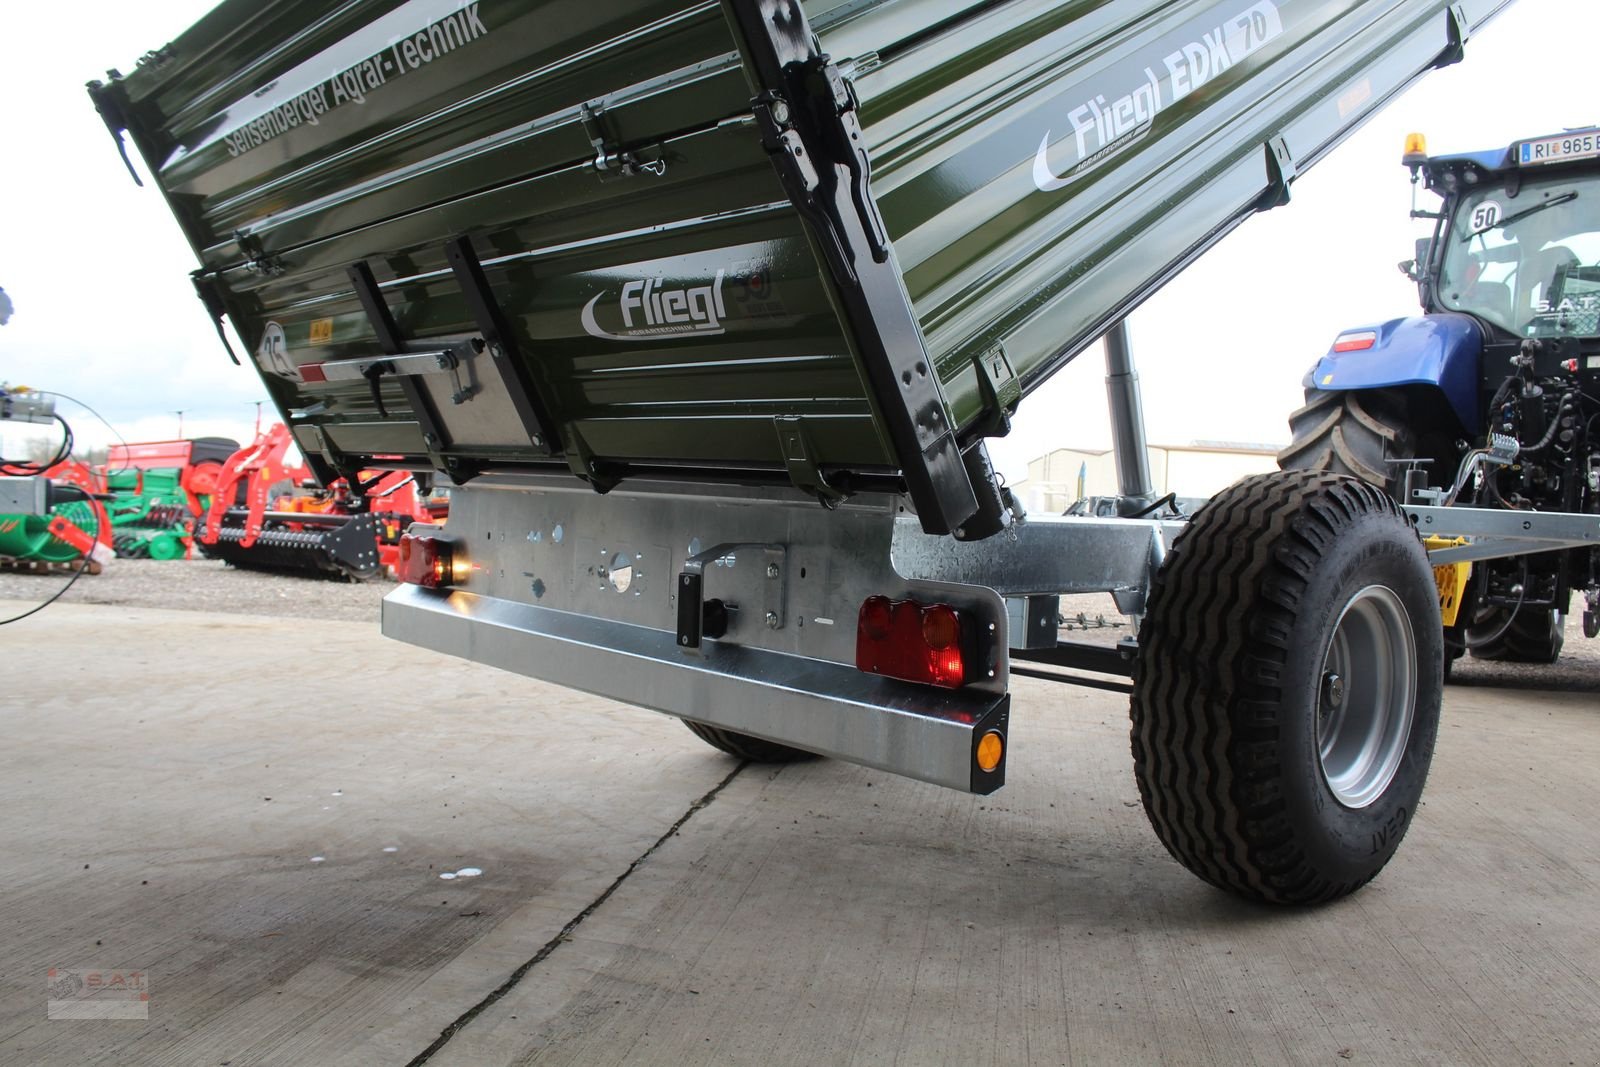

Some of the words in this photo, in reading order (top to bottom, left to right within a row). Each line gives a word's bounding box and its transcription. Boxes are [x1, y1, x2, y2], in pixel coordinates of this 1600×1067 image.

[224, 84, 330, 157] Sensenberger
[331, 1, 487, 104] Agrar-Technik
[1067, 67, 1161, 160] Fliegl
[1163, 27, 1232, 100] EDK
[1236, 10, 1267, 54] 70
[1535, 143, 1550, 158] RI
[1474, 207, 1497, 229] 50
[620, 269, 726, 330] Fliegl
[628, 324, 695, 336] AGRARTECHNIK
[1370, 806, 1407, 855] CEAT
